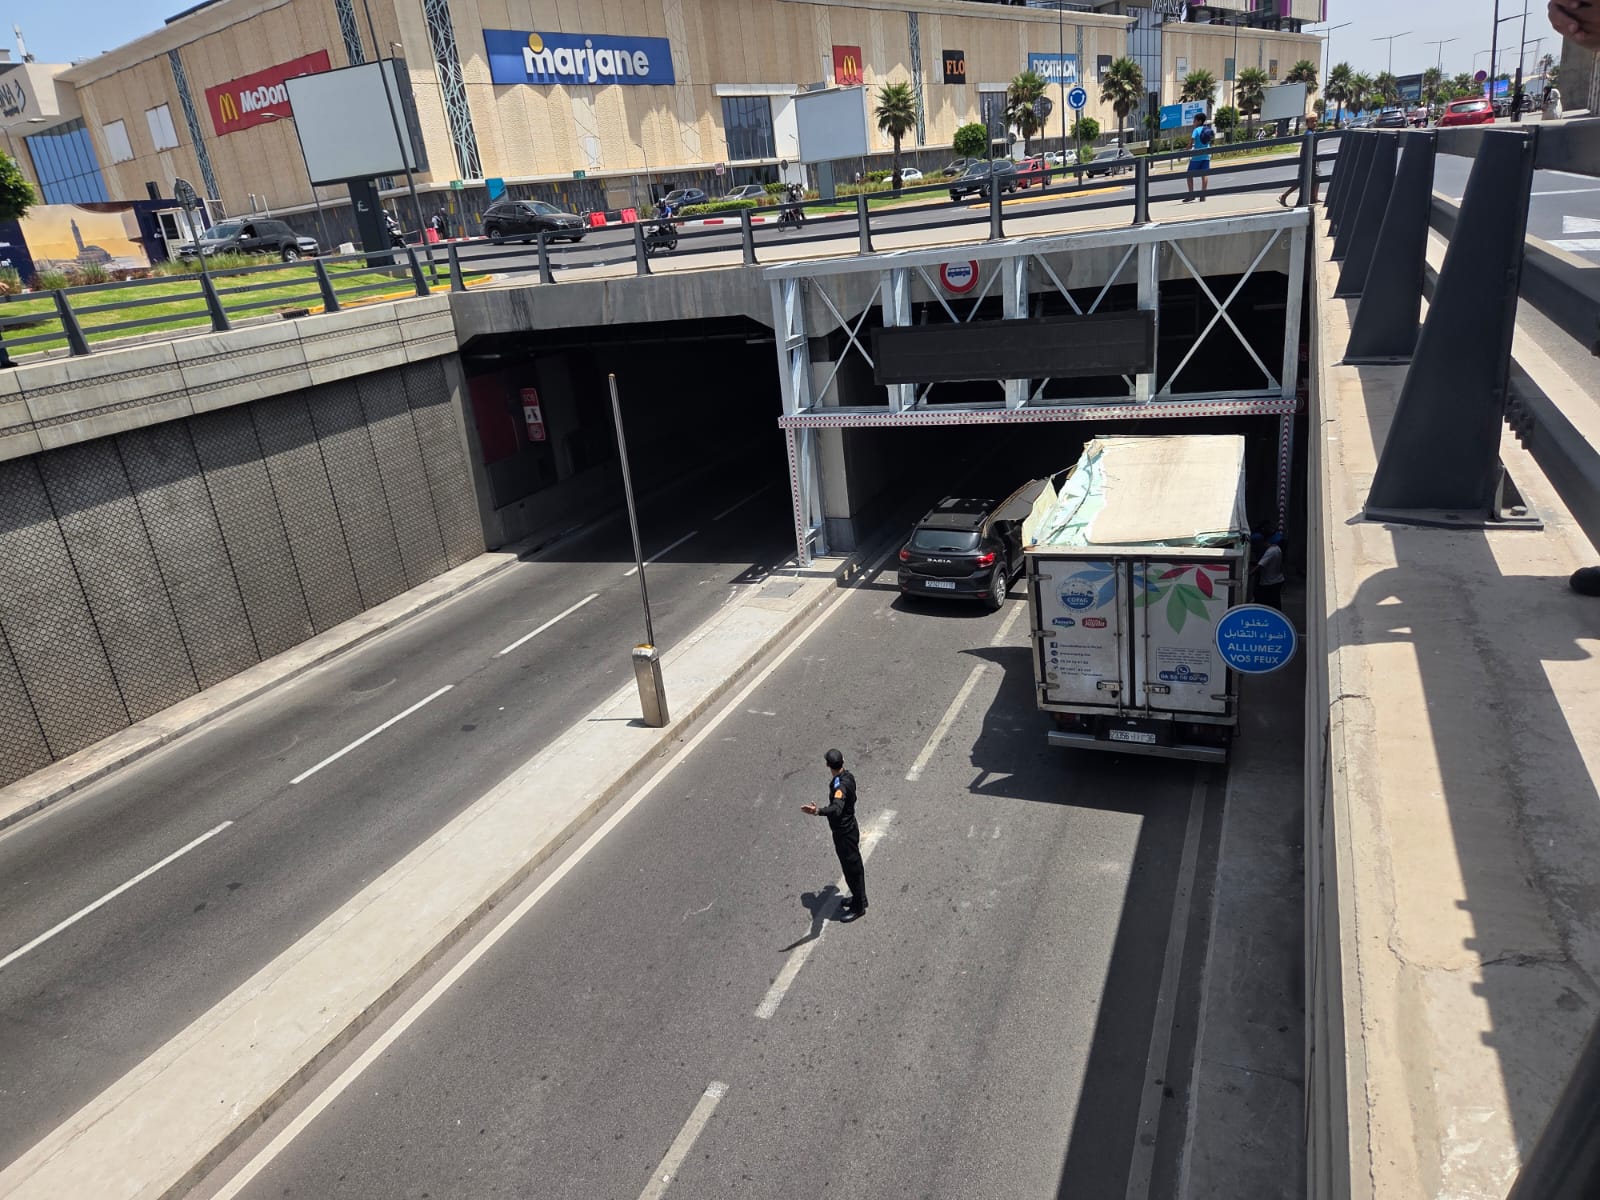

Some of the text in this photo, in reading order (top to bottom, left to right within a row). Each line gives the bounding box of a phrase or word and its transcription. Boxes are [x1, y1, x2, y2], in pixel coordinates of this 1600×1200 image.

[522, 39, 650, 83] marjane
[1227, 642, 1282, 653] ALLUMEZ
[1230, 654, 1279, 664] VOS FEUX
